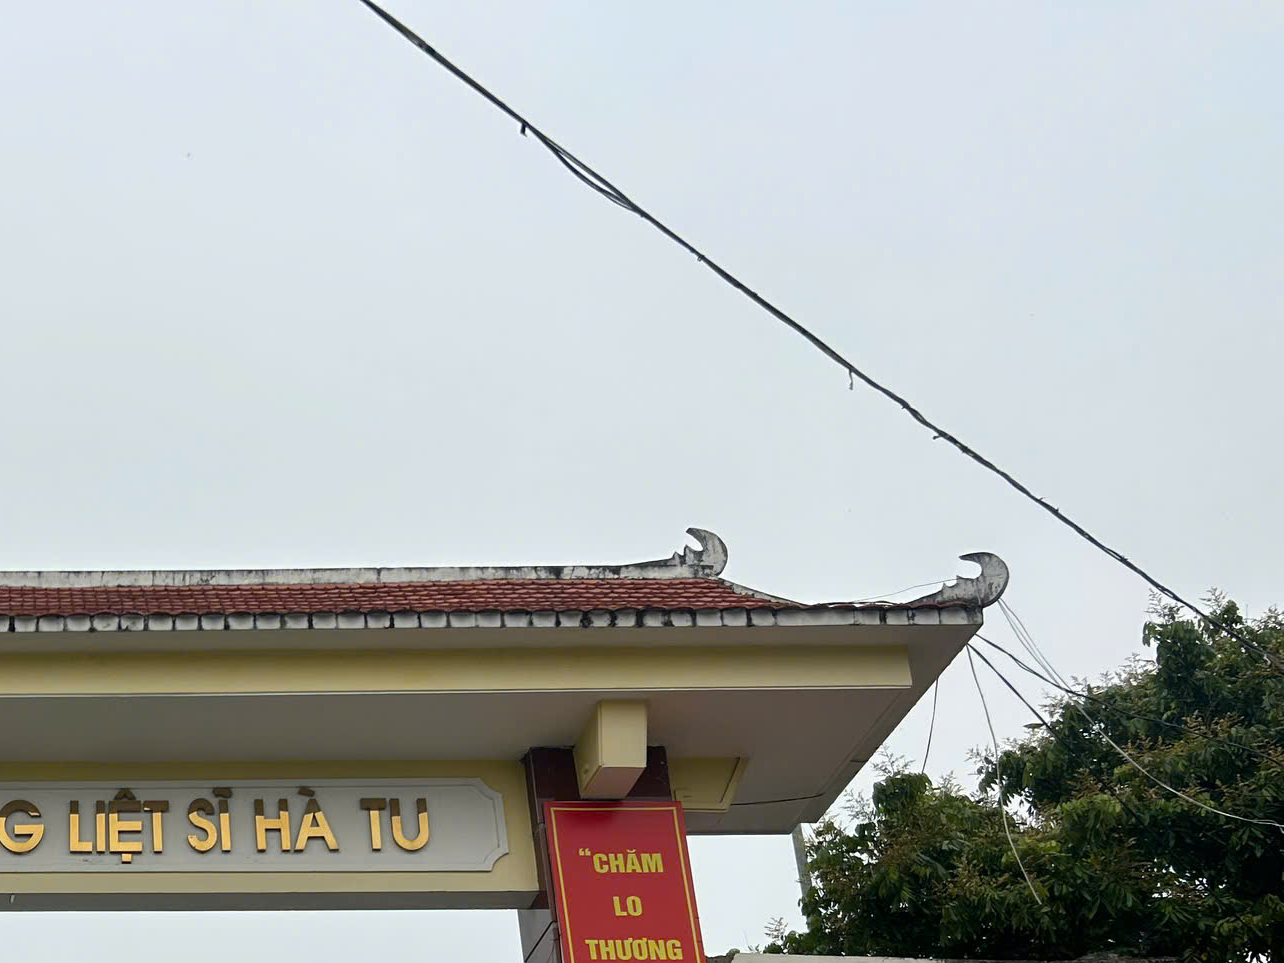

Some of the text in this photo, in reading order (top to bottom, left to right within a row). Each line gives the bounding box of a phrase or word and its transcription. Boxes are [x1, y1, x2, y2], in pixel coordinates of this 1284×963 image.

[69, 788, 169, 865] LIỆT
[187, 787, 232, 853] SĨ
[254, 787, 340, 853] HÀ
[359, 798, 430, 852] TU
[612, 895, 643, 917] LO
[584, 937, 684, 961] THƯƠNG
